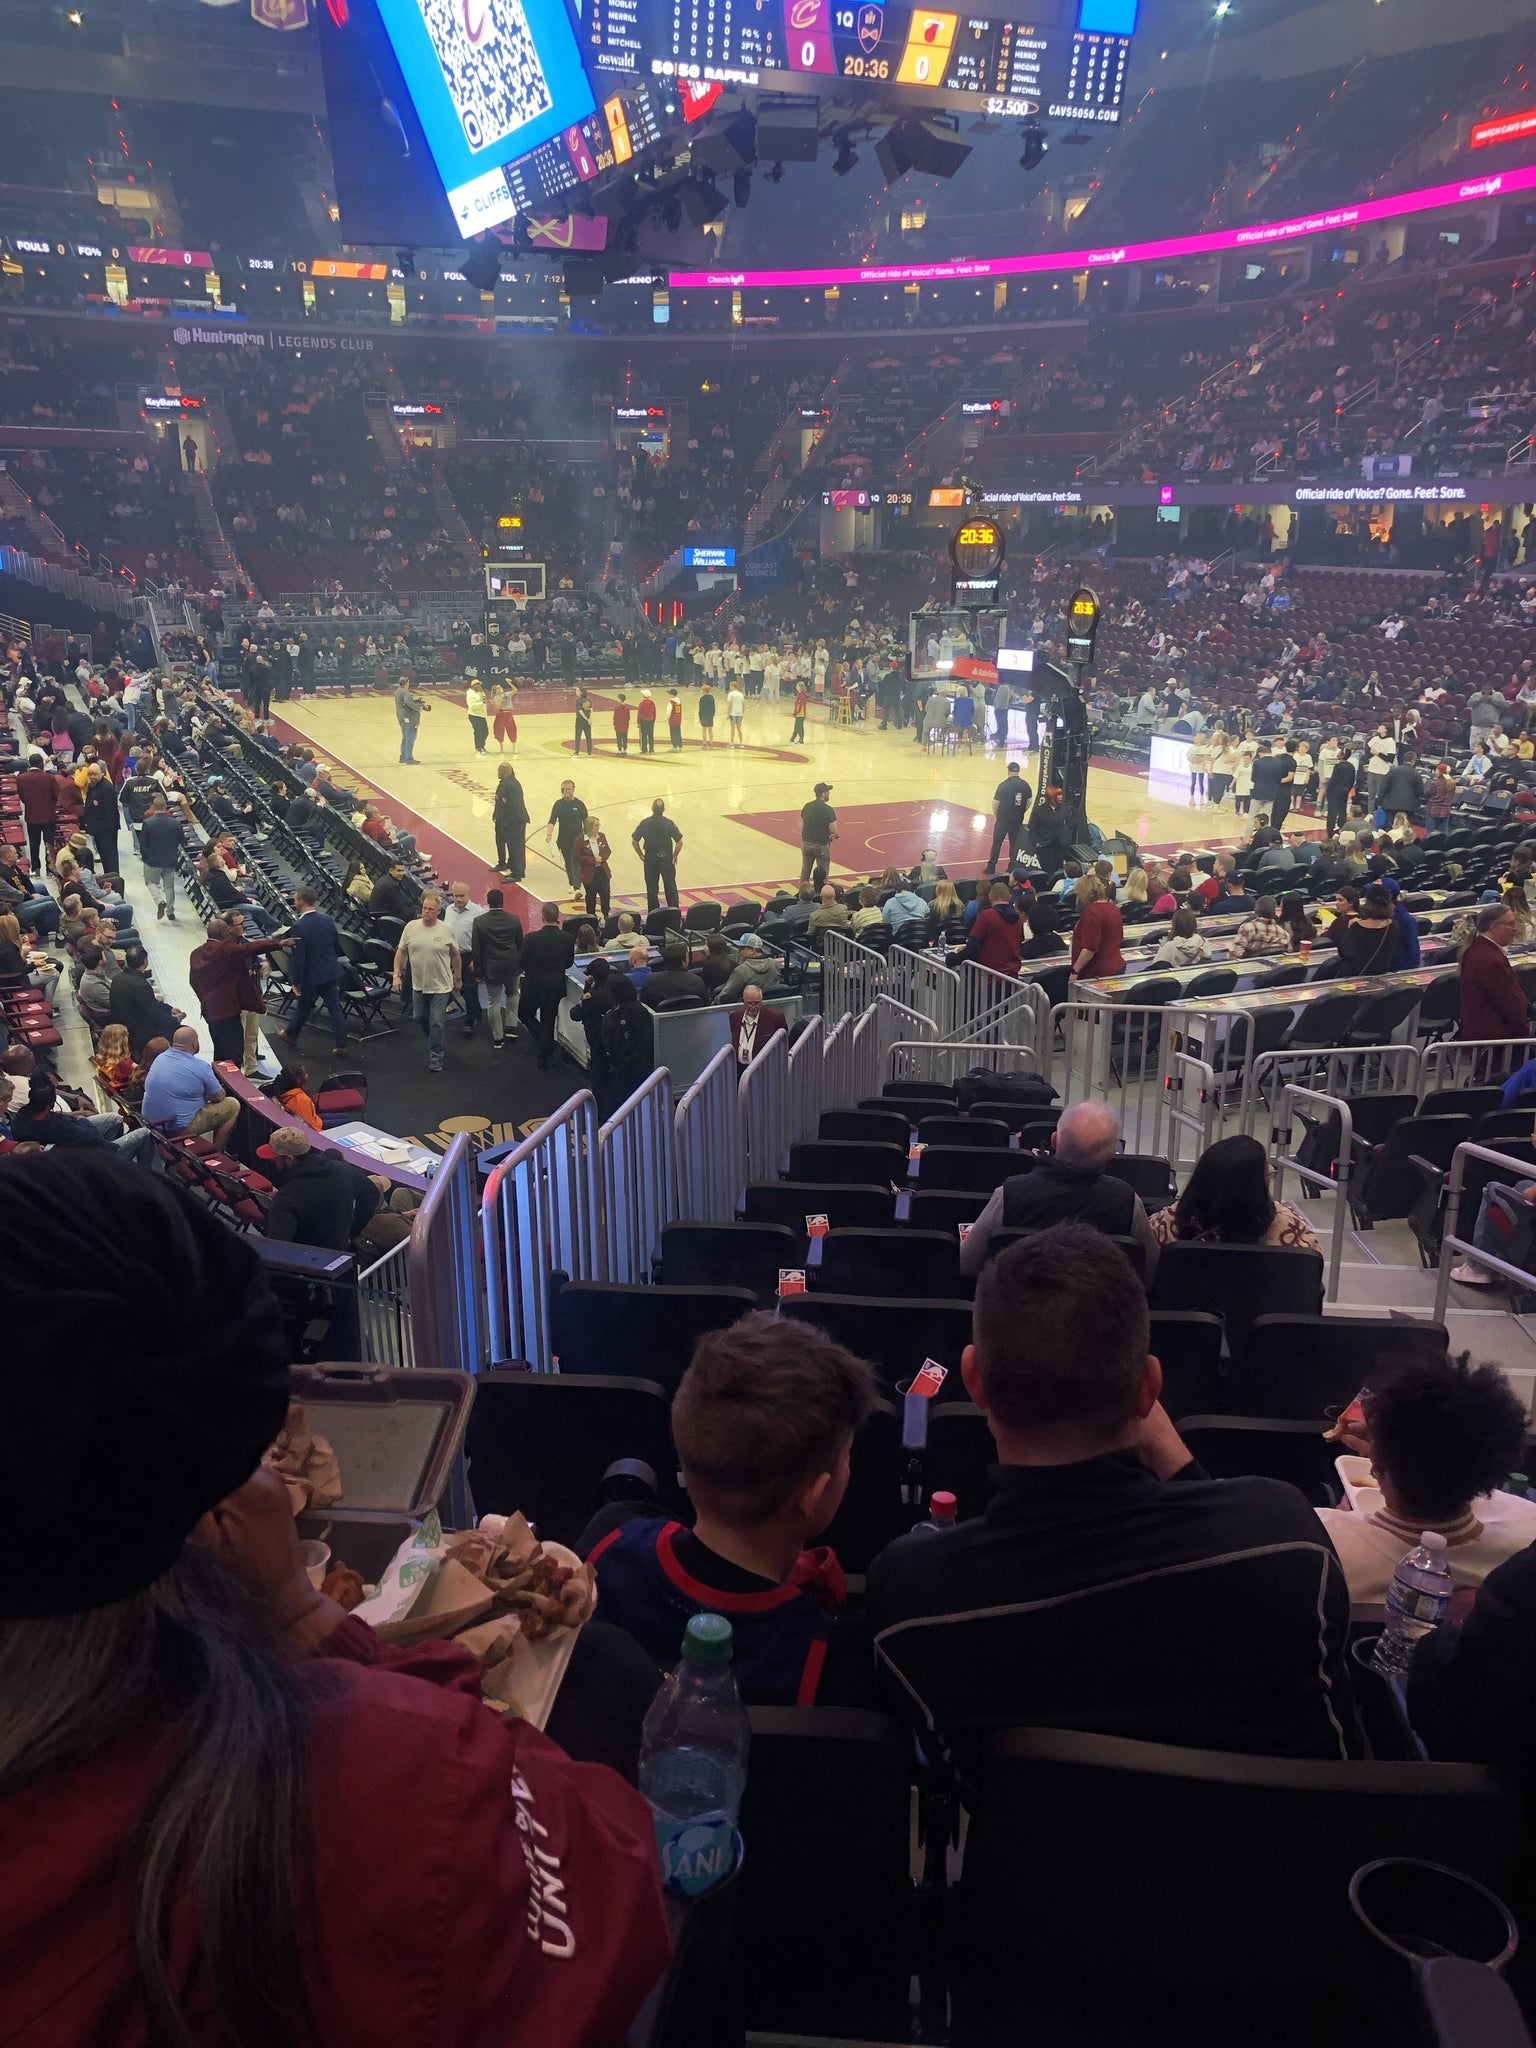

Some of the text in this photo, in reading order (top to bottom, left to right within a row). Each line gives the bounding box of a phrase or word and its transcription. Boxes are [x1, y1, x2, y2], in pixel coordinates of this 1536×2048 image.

[608, 11, 637, 23] MERRILL
[836, 11, 854, 28] 1Q
[608, 24, 626, 34] ELLIS
[969, 20, 989, 30] FOULS
[1017, 26, 1035, 36] HEAT
[742, 28, 752, 38] FG
[766, 32, 772, 41] 0
[975, 29, 981, 39] 0
[591, 35, 642, 49] 45 MITCHELL
[766, 44, 772, 54] 0
[801, 42, 815, 66] 0
[1016, 39, 1047, 49] ADEBAYO
[1074, 45, 1079, 54] 0
[1091, 47, 1096, 56] 0
[1104, 48, 1109, 57] 0
[1120, 49, 1125, 58] 0
[598, 51, 635, 68] oswald
[741, 55, 754, 65] TOL
[765, 58, 775, 67] CH
[1015, 51, 1037, 60] HERRO
[844, 56, 889, 79] 20:36
[980, 58, 985, 67] 0
[998, 60, 1040, 72] 22 WIGGINS
[704, 66, 759, 85] RAFFLE
[915, 61, 930, 80] 0
[979, 71, 984, 79] 0
[947, 80, 960, 89] TOL
[968, 82, 979, 90] CH
[1012, 75, 1037, 84] POWELL
[1011, 86, 1041, 95] MITCHELL
[987, 97, 1028, 116] $2,500
[1049, 104, 1119, 121] CAVS5050.COM
[580, 156, 589, 175] 0
[595, 149, 614, 171] 20:36
[1459, 182, 1486, 197] Check
[474, 184, 510, 214] CLIFFS
[1237, 230, 1264, 242] Official
[16, 240, 50, 254] FOULS
[57, 244, 65, 255] 0
[77, 246, 102, 257] FG%
[111, 248, 120, 259] 0
[183, 253, 192, 265] 0
[249, 259, 274, 269] 20:36
[291, 262, 307, 272] 1Q
[329, 264, 336, 275] 0
[420, 271, 427, 280] 0
[500, 273, 518, 282] TOL
[525, 274, 531, 283] 7
[1088, 254, 1111, 263] Check
[860, 270, 887, 280] Official
[910, 267, 935, 278] Voice?
[707, 276, 730, 284] Check
[192, 327, 374, 351] Huntington LEGENDS CLUB
[145, 398, 181, 407] KeyBank
[963, 403, 991, 411] KeyBank
[393, 405, 425, 414] KeyBank
[617, 409, 647, 417] KeyBank
[824, 497, 829, 505] 0
[858, 493, 865, 504] 0
[886, 493, 912, 504] 20:36
[934, 493, 940, 503] 0
[999, 492, 1011, 501] ride
[1020, 492, 1036, 502] Voice?
[1036, 492, 1052, 501] Gone.
[1053, 492, 1067, 501] Feet:
[1067, 492, 1082, 501] Sore.
[1295, 488, 1327, 500] Official
[1355, 487, 1385, 500] Voice?
[1385, 487, 1413, 499] Gone.
[1414, 486, 1440, 499] Feet:
[1440, 486, 1466, 498] Sore.
[959, 529, 994, 545] 20:36
[693, 549, 725, 558] SHERWIN
[745, 569, 778, 577] BUSINESS
[968, 580, 997, 589] TISSOT
[1073, 600, 1094, 616] 20:36
[133, 785, 151, 793] HEAT
